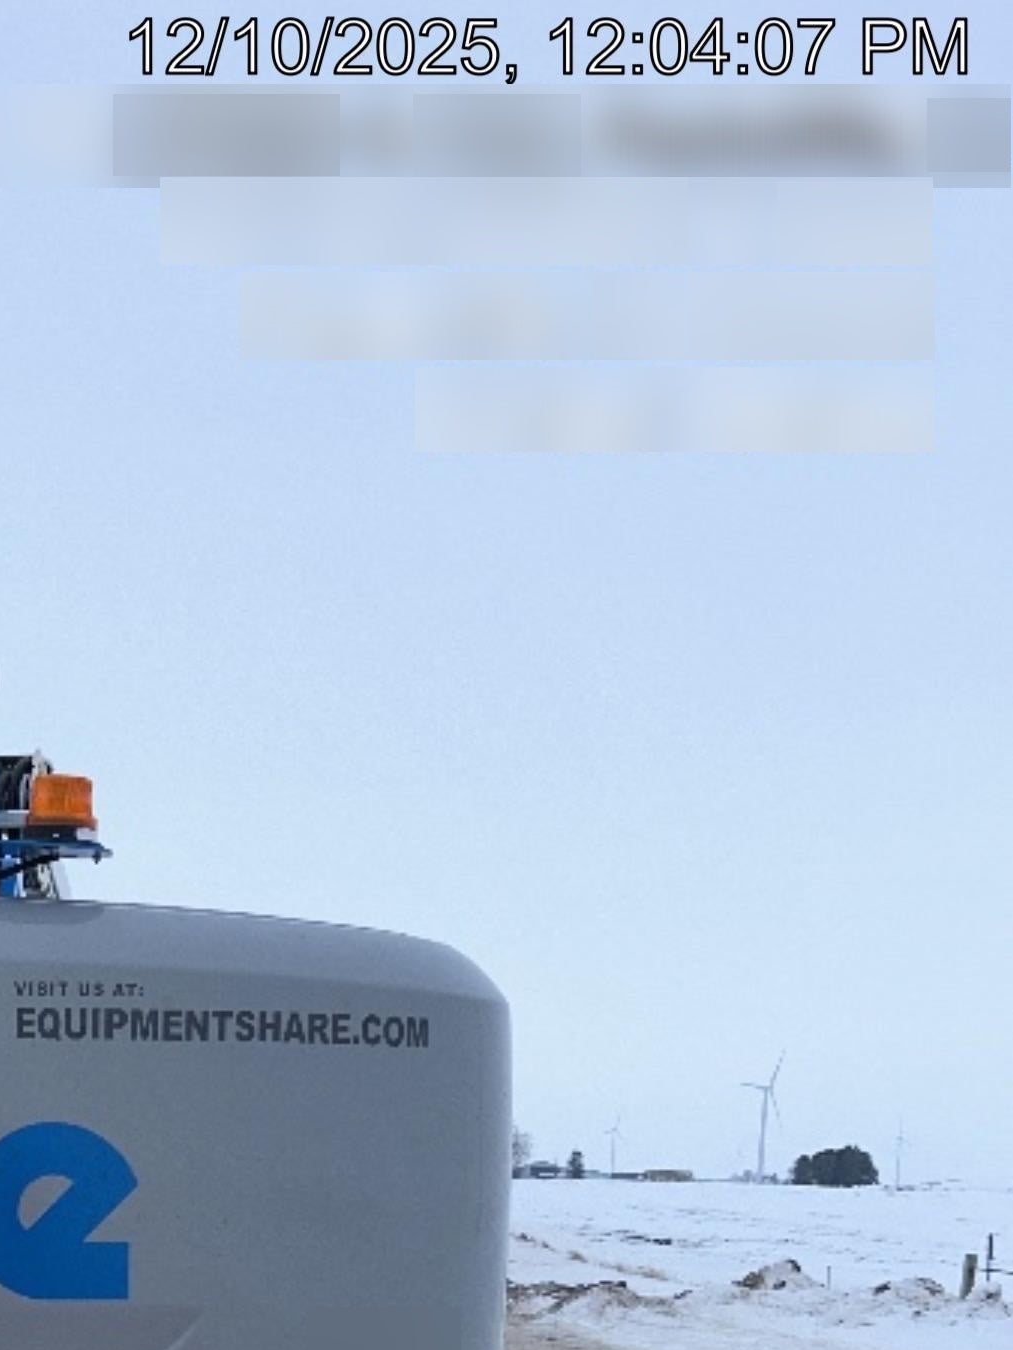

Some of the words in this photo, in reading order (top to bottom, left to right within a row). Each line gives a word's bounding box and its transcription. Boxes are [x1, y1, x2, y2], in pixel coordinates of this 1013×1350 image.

[13, 980, 69, 997] VISIT
[79, 981, 105, 997] US
[111, 983, 144, 998] AT:
[15, 1007, 430, 1048] EQUIPMENTSHARE.COM
